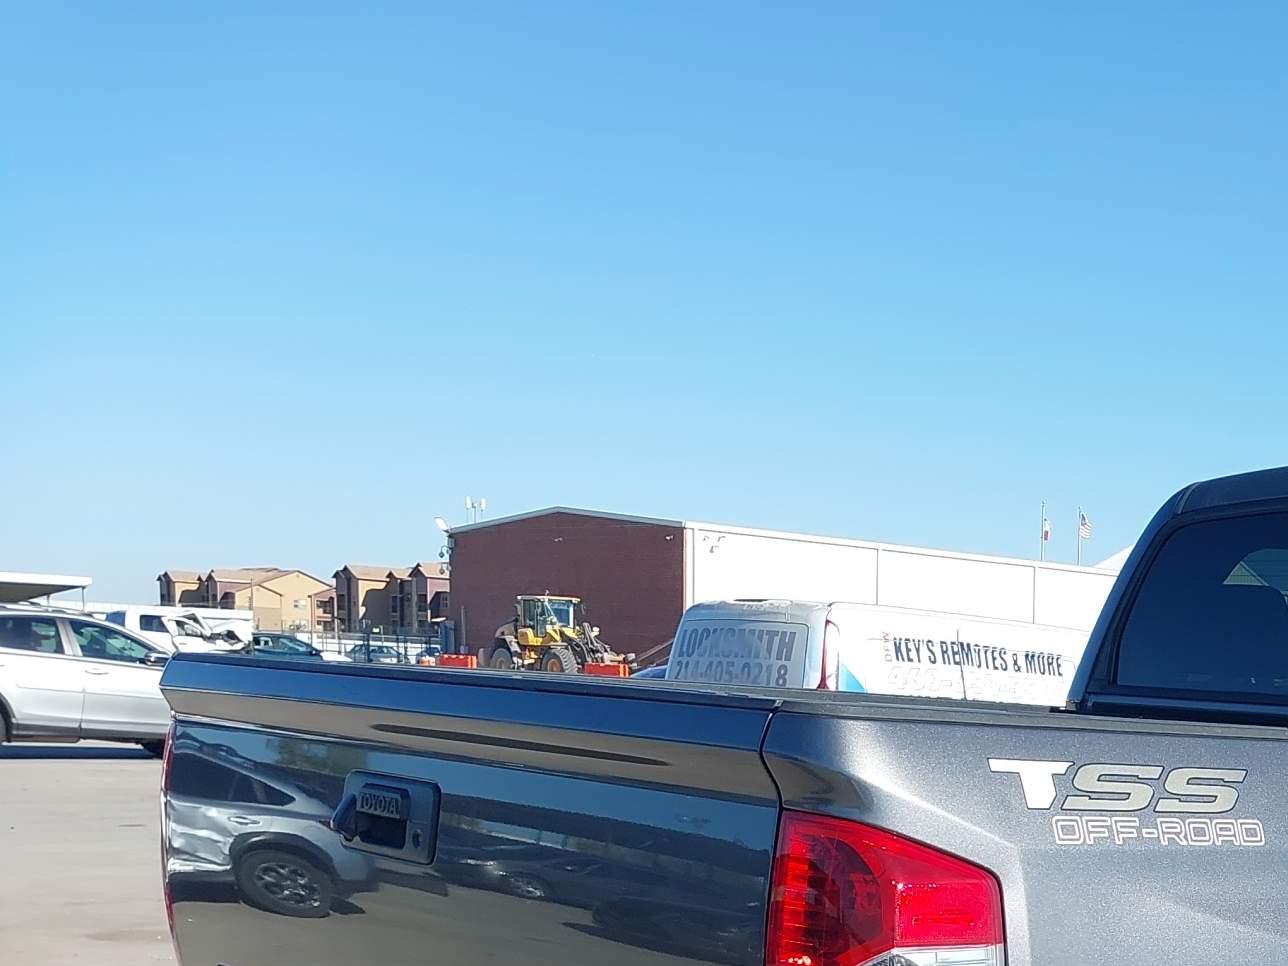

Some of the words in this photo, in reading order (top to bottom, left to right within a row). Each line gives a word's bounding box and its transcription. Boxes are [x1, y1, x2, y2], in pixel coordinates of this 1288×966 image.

[893, 636, 938, 665] KEY'S
[940, 640, 1008, 671] REMOTES
[1012, 653, 1022, 672] &
[1024, 650, 1063, 677] MORE
[987, 757, 1248, 813] TSS
[359, 791, 401, 817] TOYOTA
[1052, 815, 1265, 845] OFF-ROAD
